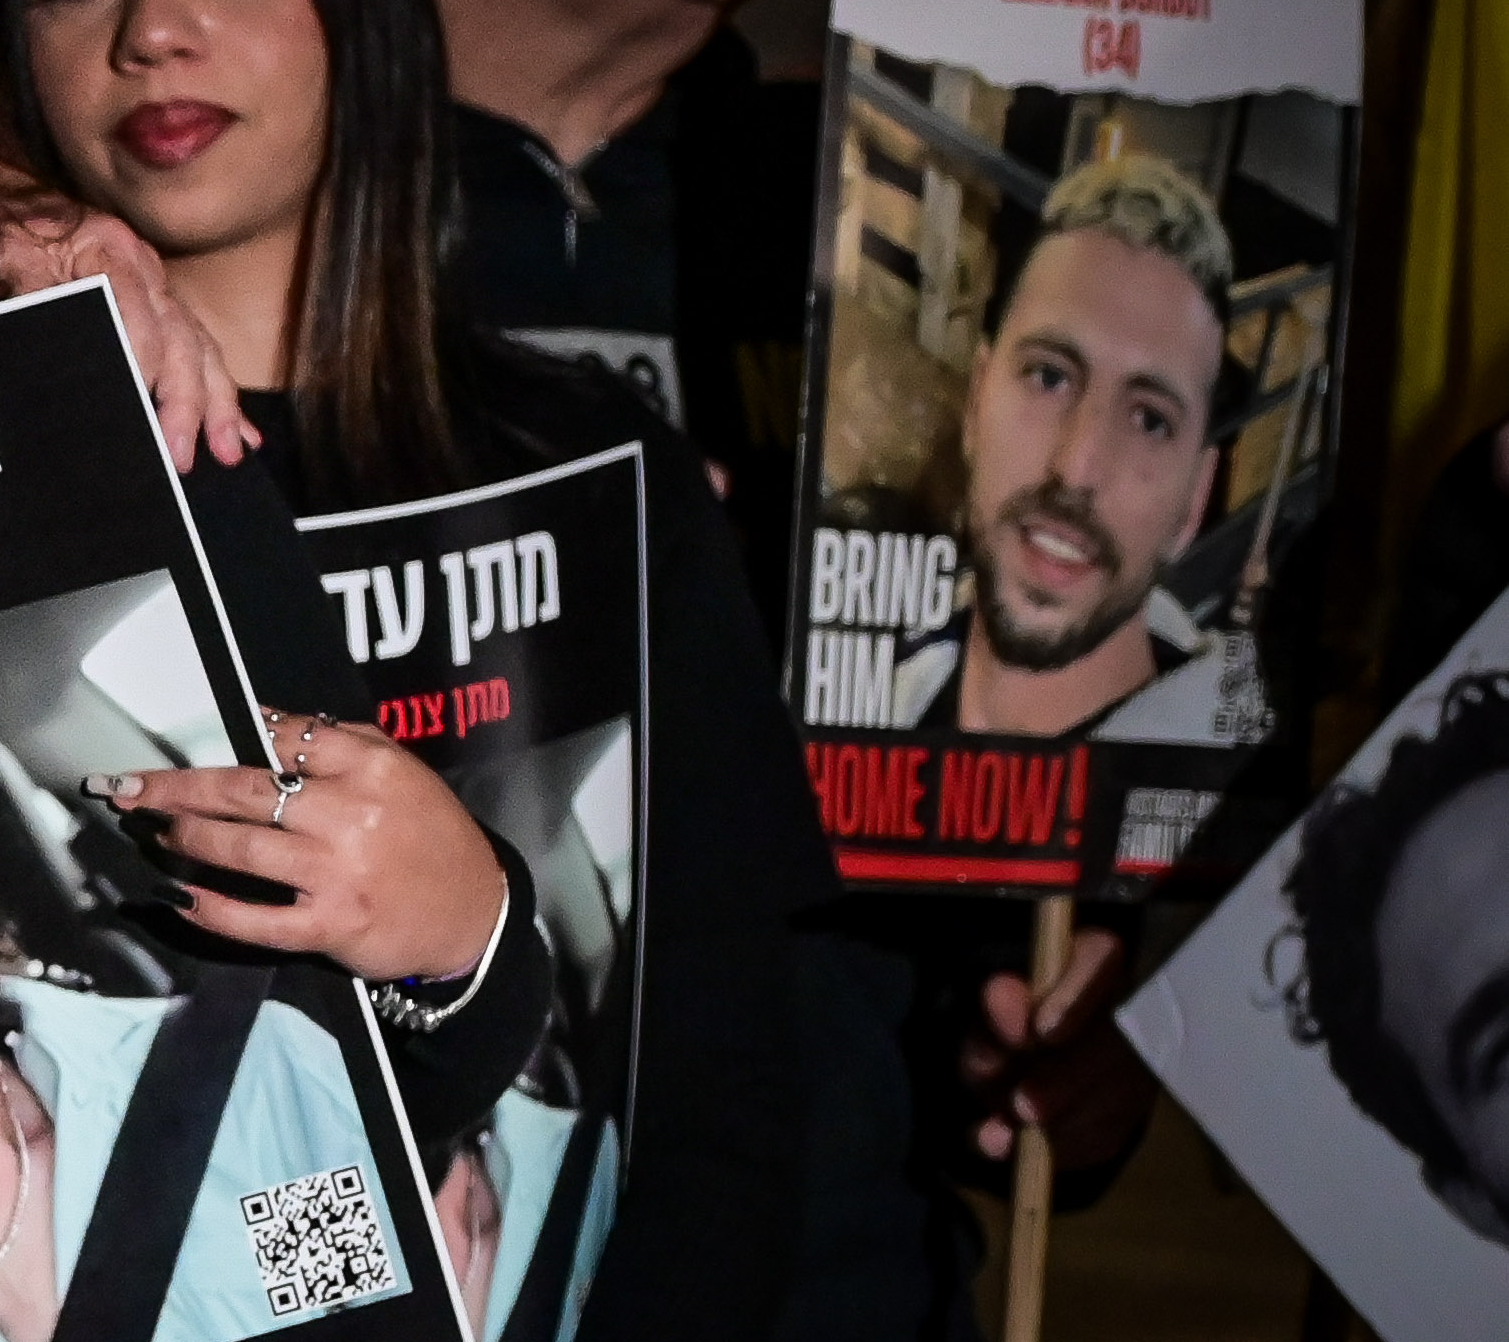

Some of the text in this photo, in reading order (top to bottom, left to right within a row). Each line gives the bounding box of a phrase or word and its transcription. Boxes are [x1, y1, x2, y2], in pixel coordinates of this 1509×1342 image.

[438, 530, 562, 667] מתן
[810, 527, 958, 641] BRING
[452, 676, 510, 739] מתן
[803, 629, 896, 729] HIM
[939, 744, 1092, 848] NOW!
